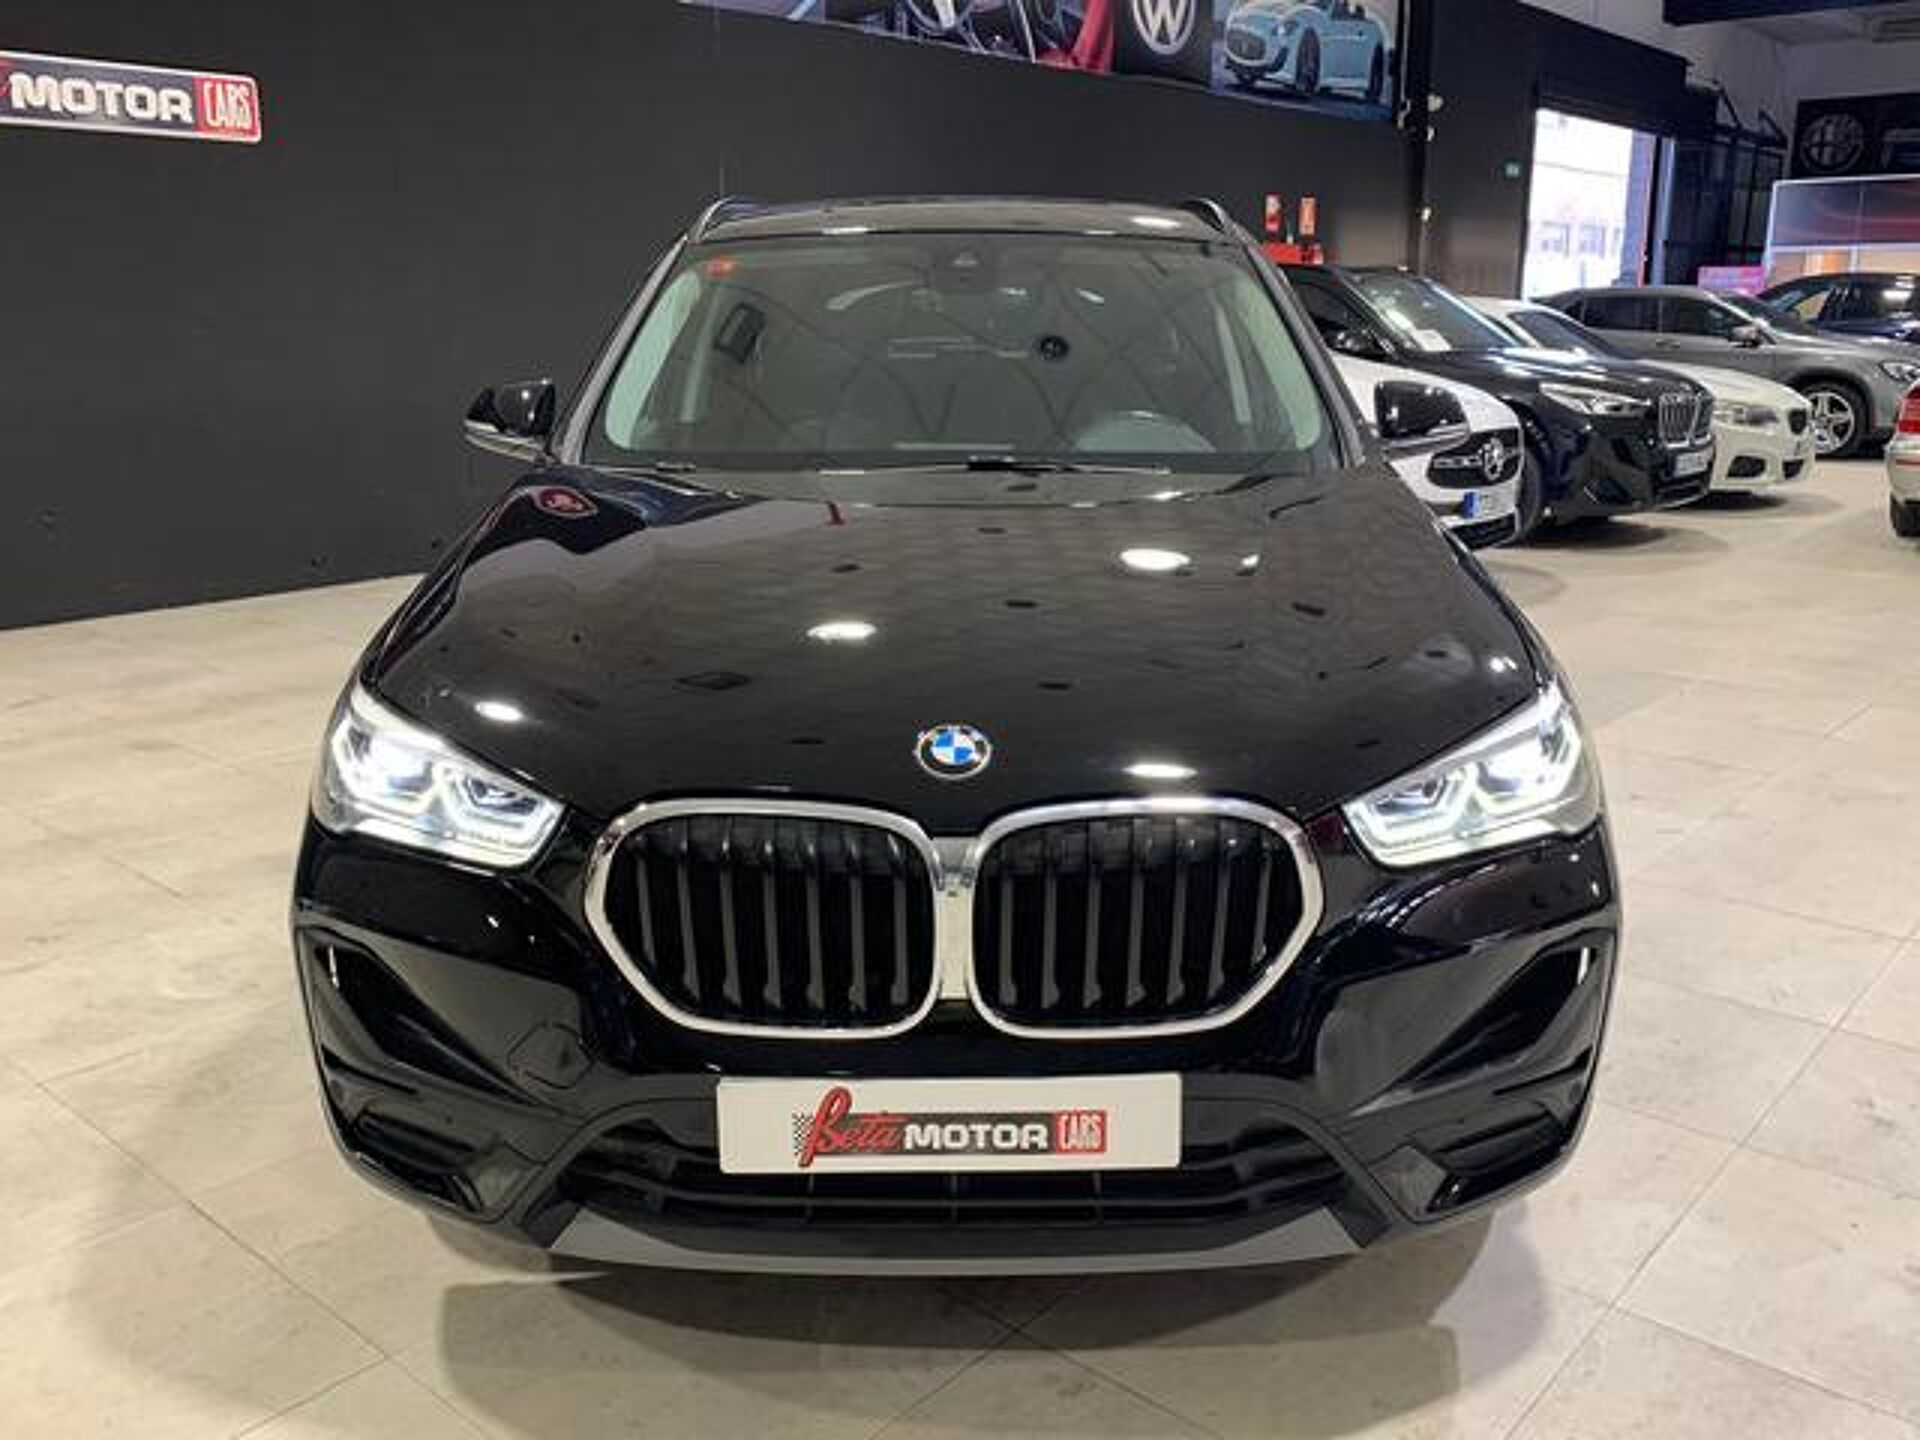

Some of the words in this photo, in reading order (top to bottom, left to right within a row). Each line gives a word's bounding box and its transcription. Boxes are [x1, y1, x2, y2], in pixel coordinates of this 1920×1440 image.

[9, 71, 194, 123] MOTOR
[203, 80, 252, 129] CARS
[798, 1086, 906, 1168] Beta
[904, 1123, 1049, 1150] MOTOR
[1059, 1113, 1102, 1150] CARS
